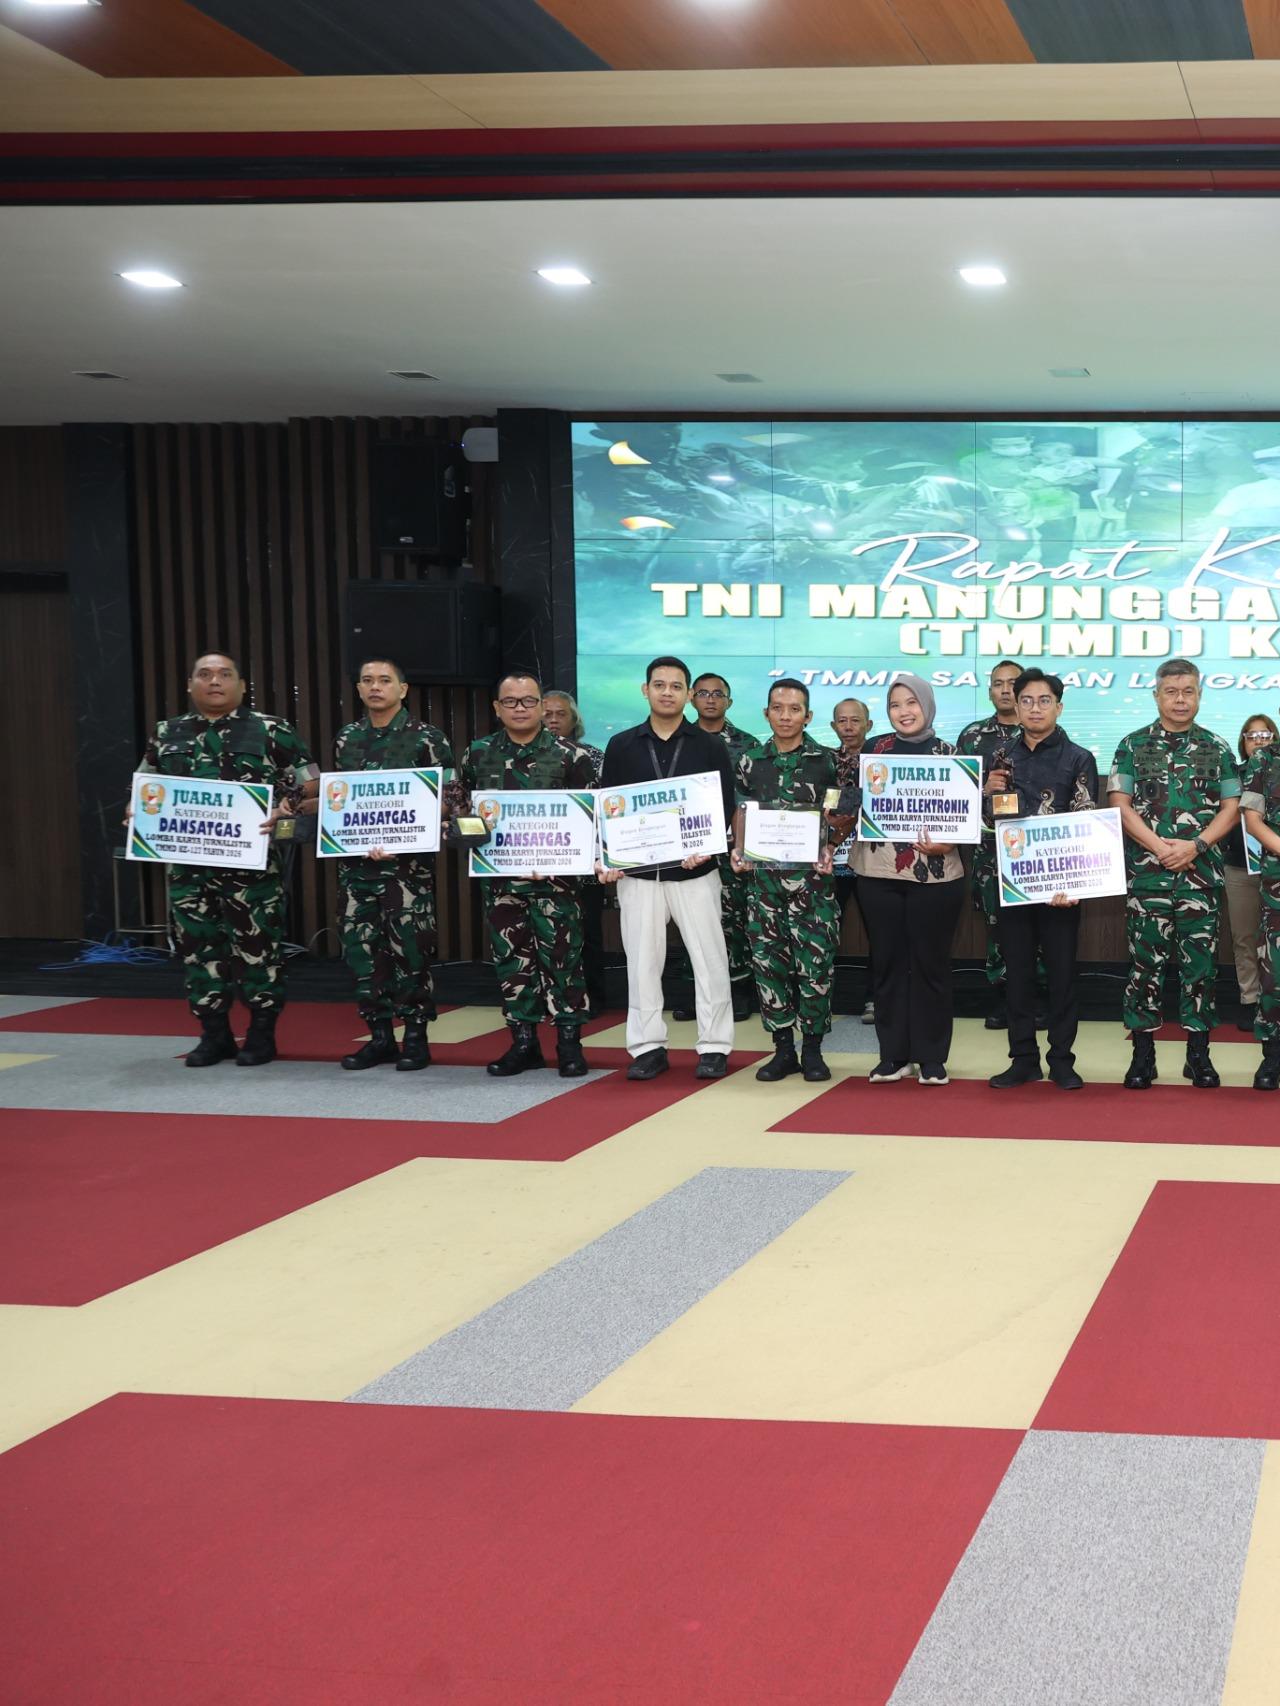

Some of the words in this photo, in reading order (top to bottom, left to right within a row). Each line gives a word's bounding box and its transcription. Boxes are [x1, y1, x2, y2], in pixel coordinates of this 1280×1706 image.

[851, 532, 1178, 598] Rapat
[650, 583, 782, 617] TNI
[900, 622, 1204, 657] (TMMD)
[931, 671, 1115, 688] SAAN
[892, 767, 936, 784] JUARA
[940, 768, 950, 781] II
[172, 789, 221, 807] JUARA
[227, 794, 233, 807] I
[352, 783, 395, 800] JUARA
[400, 782, 410, 794] II
[897, 788, 944, 796] KATEGORI
[356, 800, 404, 809] KATEGORI
[632, 789, 677, 812] JUARA
[681, 788, 687, 800] I
[872, 798, 904, 812] MEDIA
[907, 799, 969, 813] ELEKTRONIK
[174, 809, 229, 819] KATEGORI
[344, 810, 416, 826] DANSATGAS
[501, 804, 547, 820] JUARA
[551, 804, 567, 816] III
[923, 815, 967, 823] JURNALISTIK
[159, 818, 242, 837] DANSATGAS
[332, 828, 357, 836] LOMBA
[359, 827, 380, 835] KARYA
[382, 826, 425, 835] JURNALISTIK
[509, 822, 558, 830] KATEGORI
[145, 834, 174, 842] LOMBA
[176, 835, 201, 844] KARYA
[203, 837, 252, 848] JURNALISTIK
[496, 832, 571, 847] DANSATGAS
[1026, 826, 1071, 846] JUARA
[1075, 823, 1092, 836] III
[536, 849, 580, 857] JURNALISTIK
[1035, 845, 1085, 857] KATEGORI
[1011, 860, 1045, 876] MEDIA
[1048, 852, 1112, 872] ELEKTRONIK
[1014, 875, 1039, 884] LOMBA
[1041, 873, 1064, 881] KARYA
